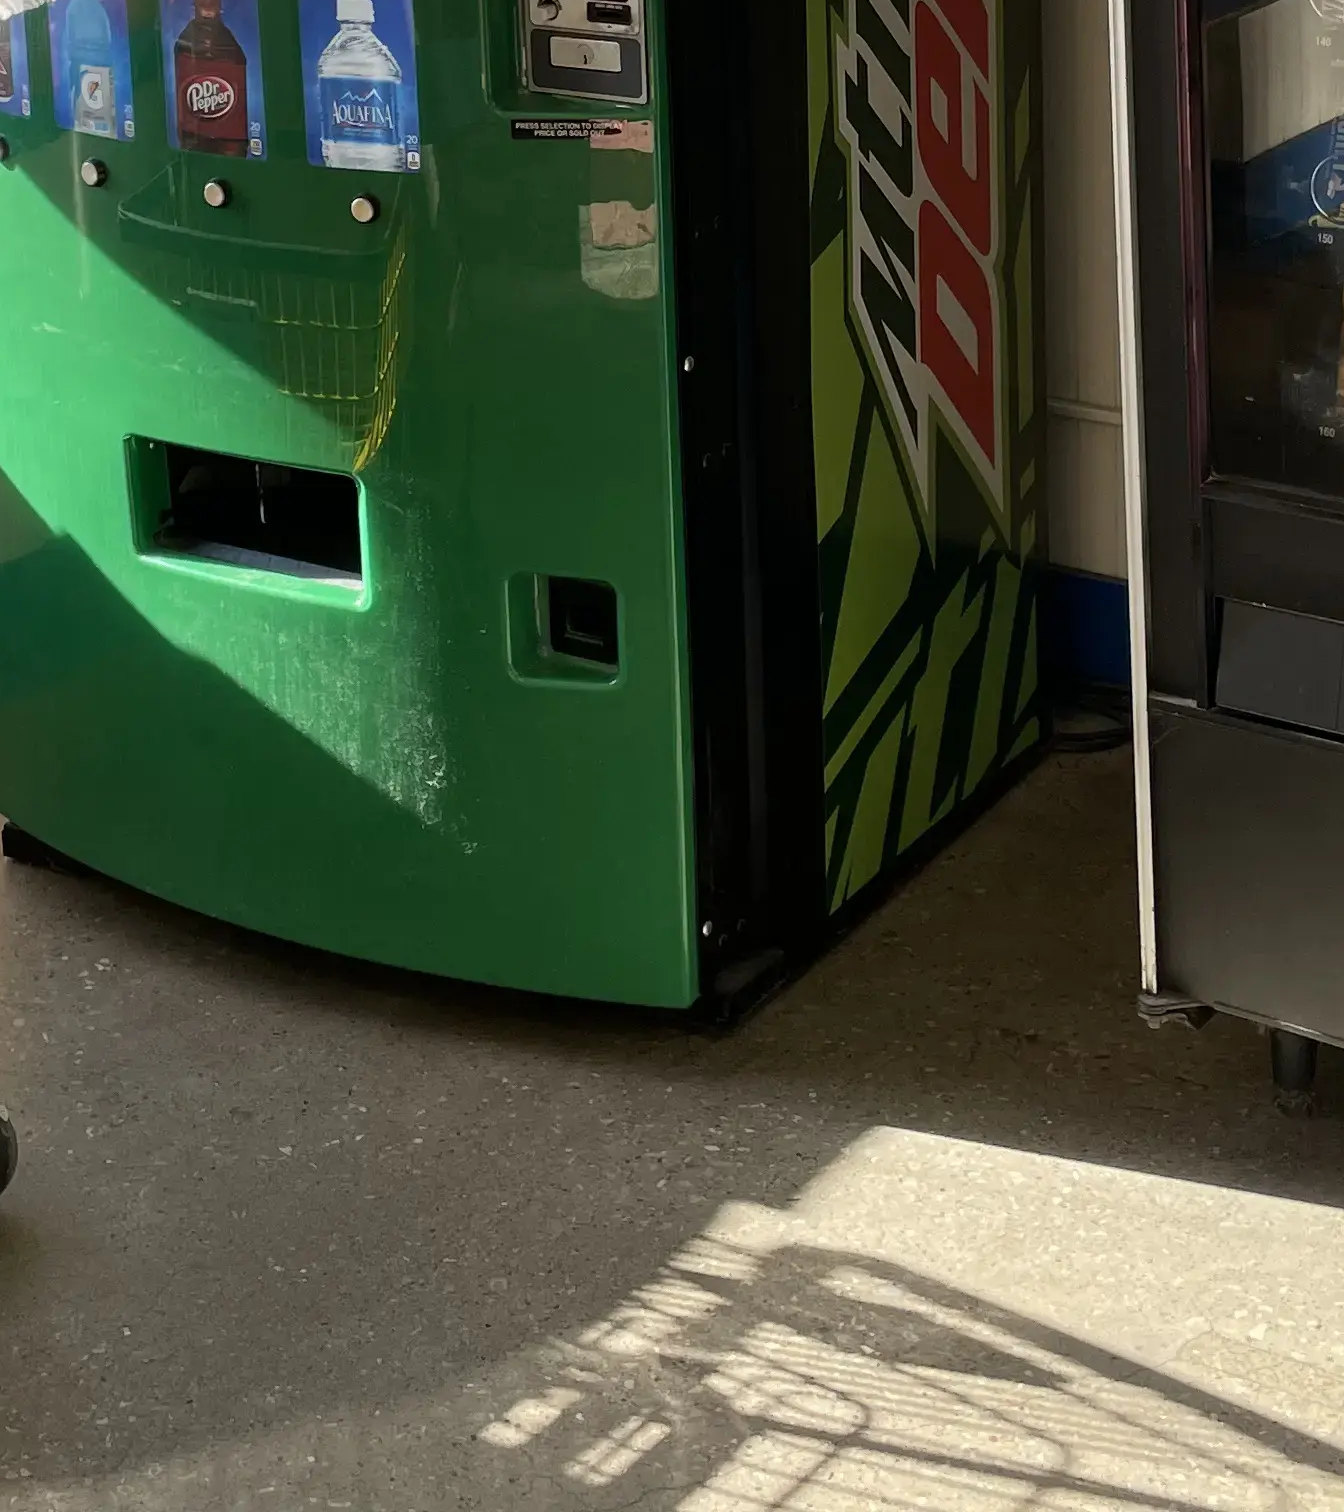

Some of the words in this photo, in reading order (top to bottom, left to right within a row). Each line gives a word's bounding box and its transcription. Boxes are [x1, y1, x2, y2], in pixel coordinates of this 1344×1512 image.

[202, 79, 220, 97] Dr
[191, 83, 231, 113] Pepper
[332, 100, 394, 130] AQUAFINA
[515, 122, 539, 130] PRESS
[540, 122, 581, 130] SELECTION
[581, 122, 592, 130] TO
[534, 129, 555, 137] PRICE
[568, 129, 589, 137] SOLD
[1317, 233, 1334, 245] 150
[1318, 426, 1336, 438] 160
